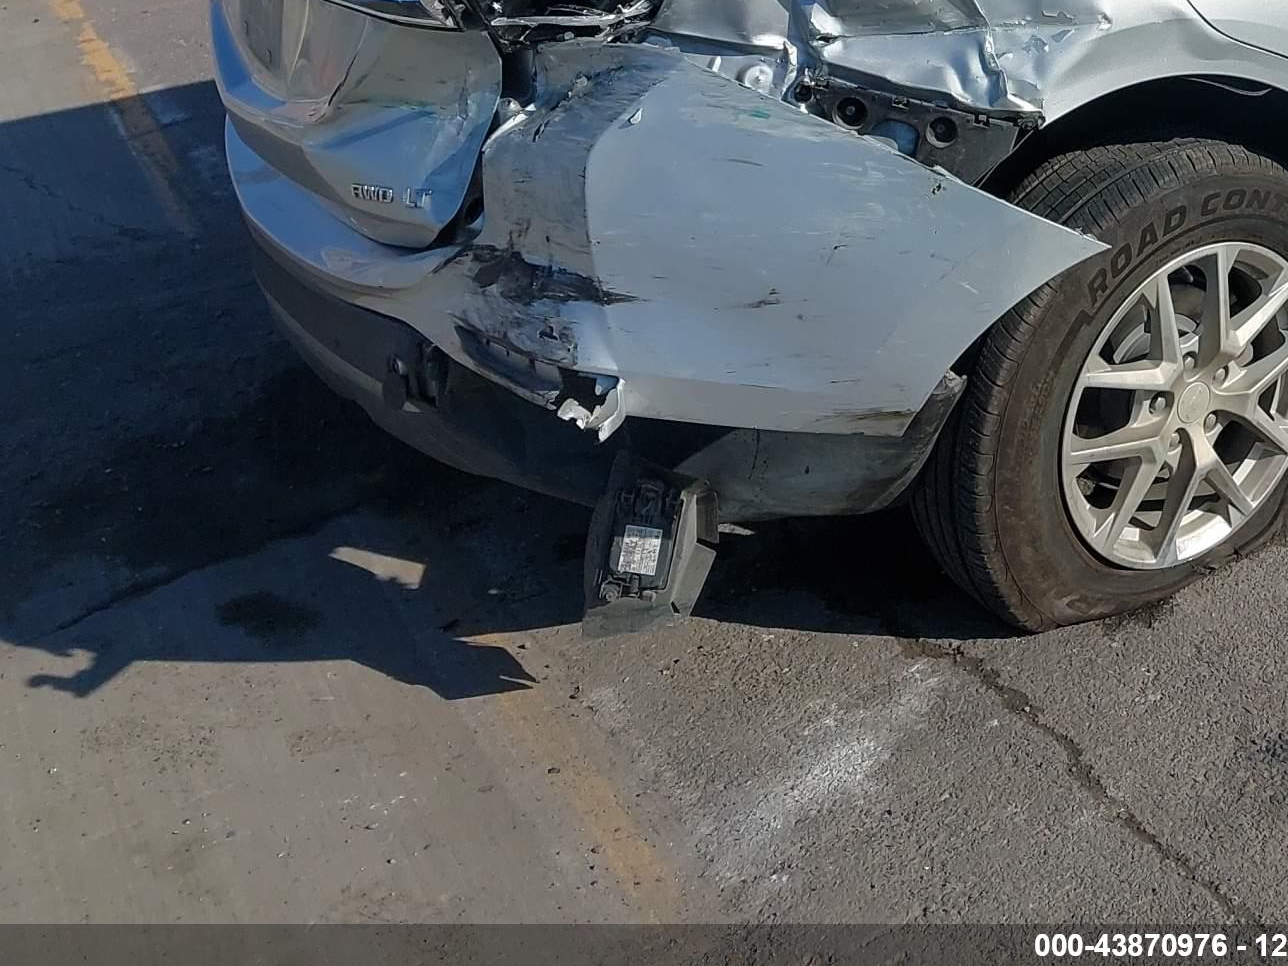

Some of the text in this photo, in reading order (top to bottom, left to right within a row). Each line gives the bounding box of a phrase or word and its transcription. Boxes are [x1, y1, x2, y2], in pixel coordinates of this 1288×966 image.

[351, 183, 432, 208] AWD LT
[1087, 204, 1187, 307] ROAD
